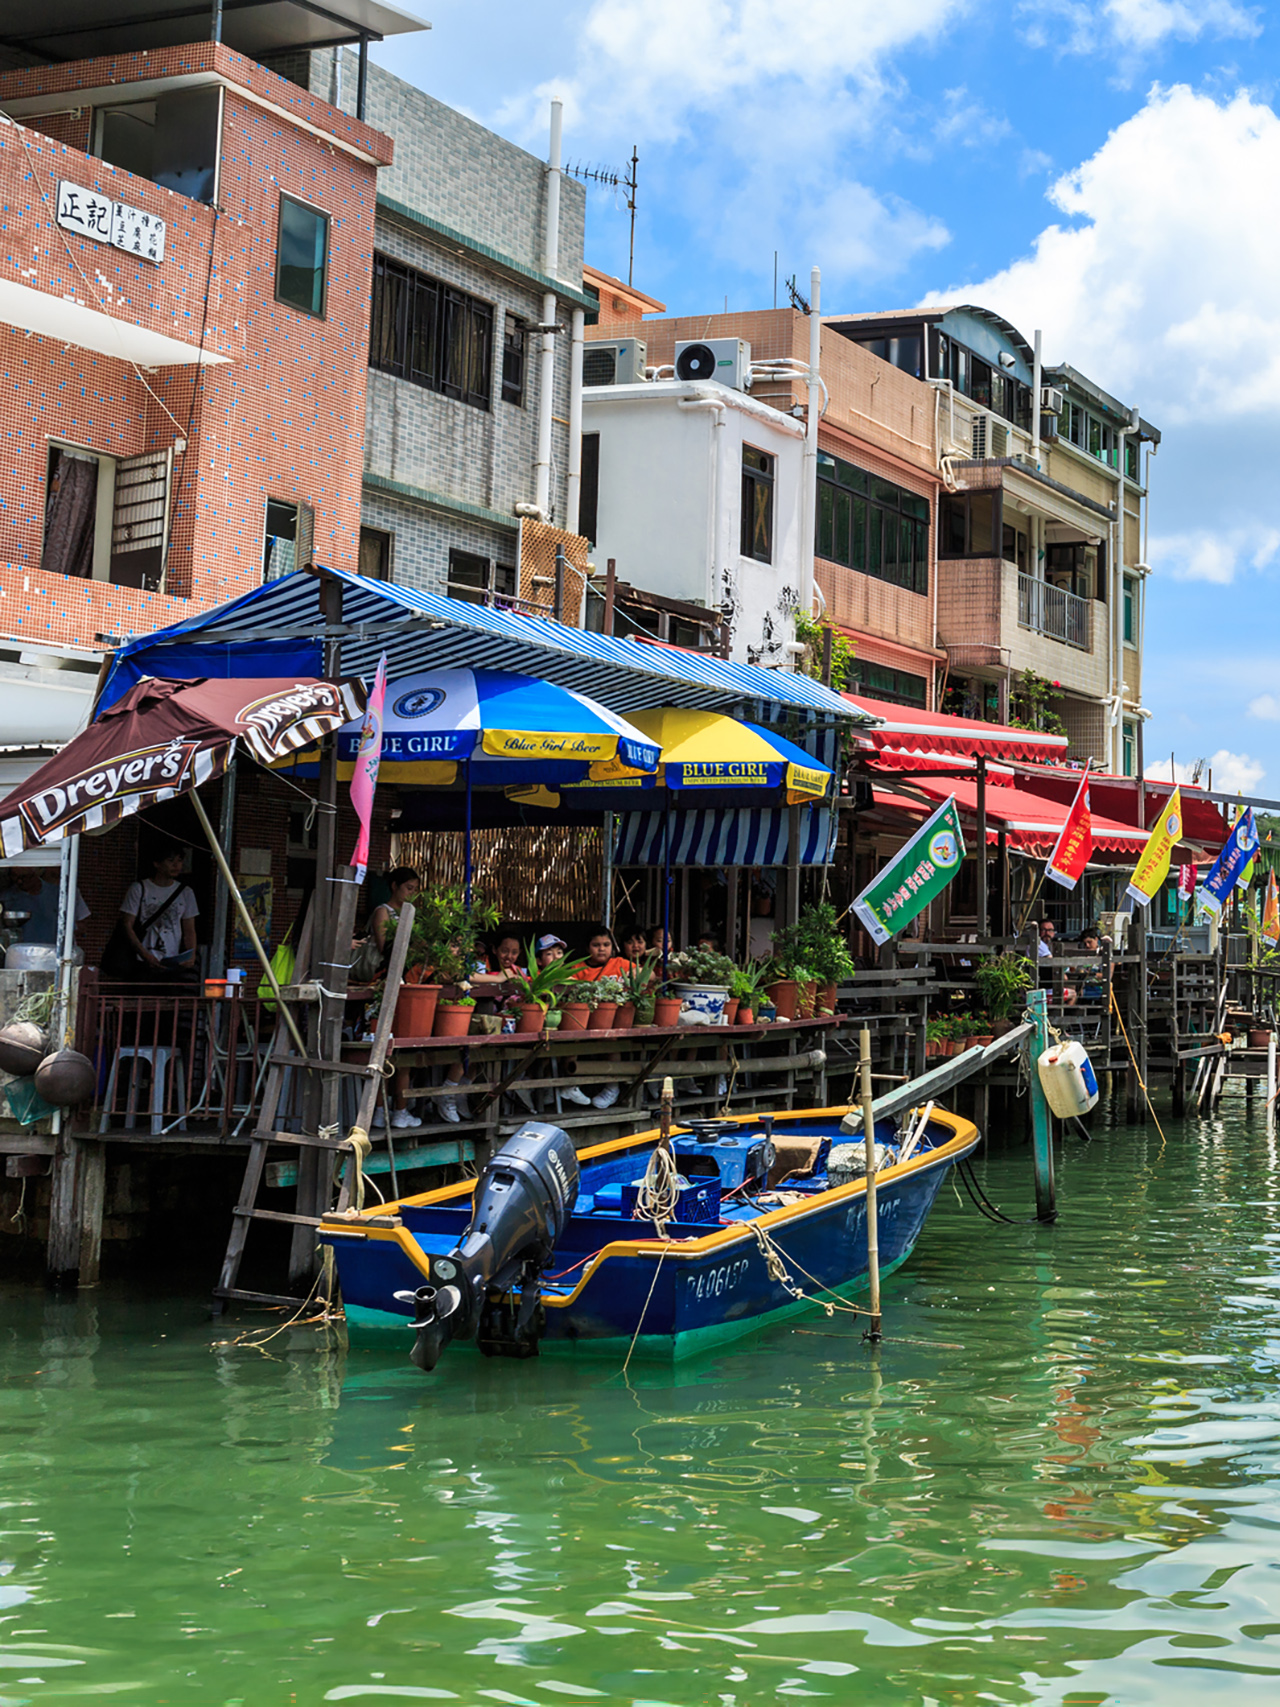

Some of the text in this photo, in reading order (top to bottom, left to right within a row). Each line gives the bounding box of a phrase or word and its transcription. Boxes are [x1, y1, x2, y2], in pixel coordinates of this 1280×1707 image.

[60, 193, 109, 235] 正記
[245, 684, 337, 738] Dreyer's
[349, 735, 454, 753] BUE GIRL
[503, 737, 601, 753] Blue Girl Beer
[30, 740, 185, 827] Dreyer's
[682, 763, 767, 777] BLUE GIRL
